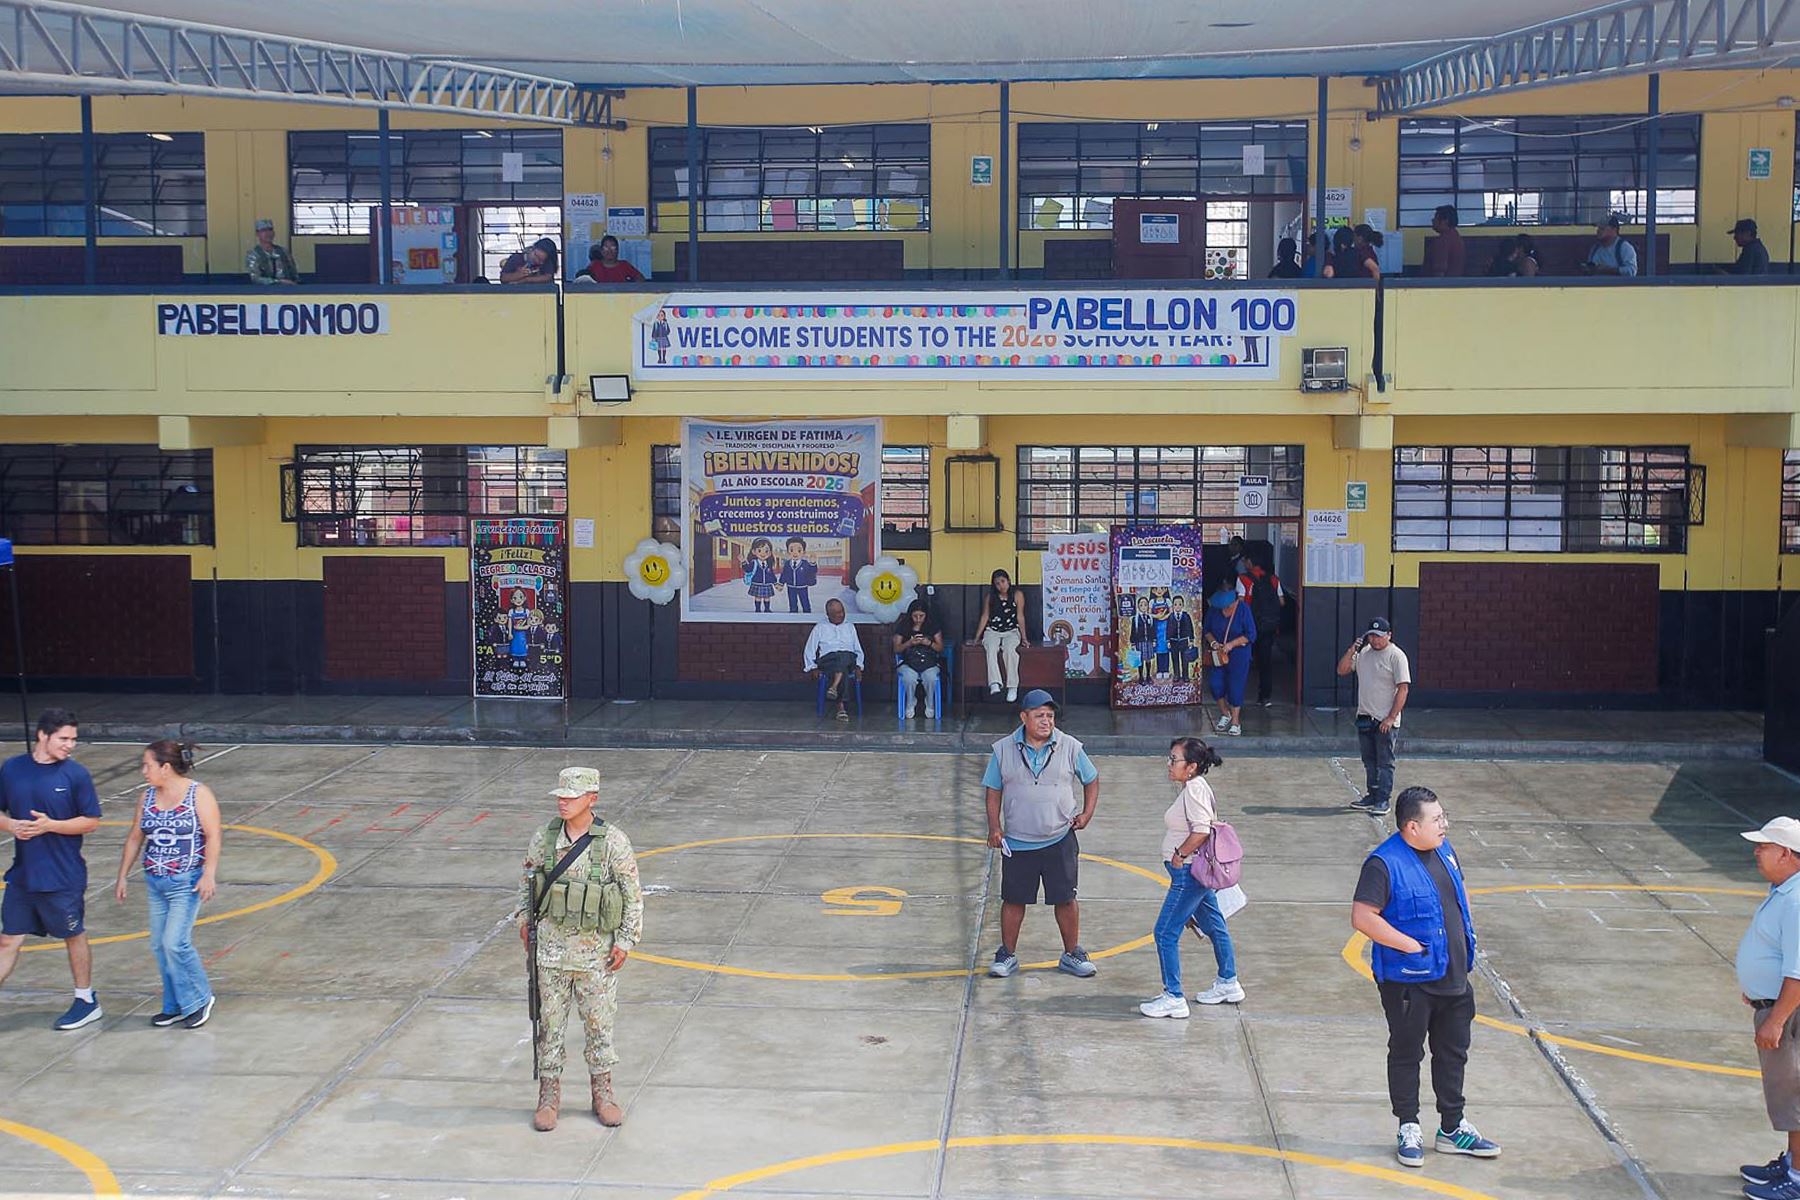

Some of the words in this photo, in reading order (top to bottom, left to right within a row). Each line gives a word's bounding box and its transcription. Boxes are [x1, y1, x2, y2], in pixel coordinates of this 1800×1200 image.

[1029, 297, 1217, 331] PABELLON
[1231, 298, 1295, 331] 100
[677, 326, 791, 348] WELCOME
[796, 325, 912, 348] STUDENTS
[918, 325, 949, 347] TO
[954, 325, 997, 347] THE
[716, 430, 733, 440] I.E.
[734, 431, 778, 440] VIRGEN
[781, 431, 797, 440] DE
[800, 430, 843, 440] FATIMA
[704, 451, 860, 476] ¡BIENVENIDOS!
[721, 478, 734, 488] AL
[736, 476, 758, 487] AÑO
[760, 477, 804, 487] ESCOLAR
[806, 475, 844, 490] 2026
[722, 496, 762, 507] Juntos
[765, 497, 840, 509] aprendemos,
[718, 509, 765, 518] crecemos
[767, 511, 774, 520] y
[776, 509, 839, 519] construimos
[1313, 514, 1342, 523] 044626
[489, 526, 517, 534] VIRGEN
[518, 526, 528, 534] DE
[730, 522, 784, 533] nuestros
[787, 520, 833, 533] sueños.
[1131, 536, 1142, 546] La
[1057, 539, 1107, 555] JESÚS
[500, 548, 533, 559] ¡Feliz!
[1060, 558, 1099, 571] VIVE
[480, 564, 516, 576] REGRESO
[523, 564, 556, 577] CLASES
[1055, 575, 1083, 584] Semana
[1085, 575, 1106, 584] Santa
[1061, 595, 1087, 604] amor,
[1089, 593, 1098, 603] fe
[1058, 607, 1064, 615] y
[148, 846, 181, 855] PARIS
